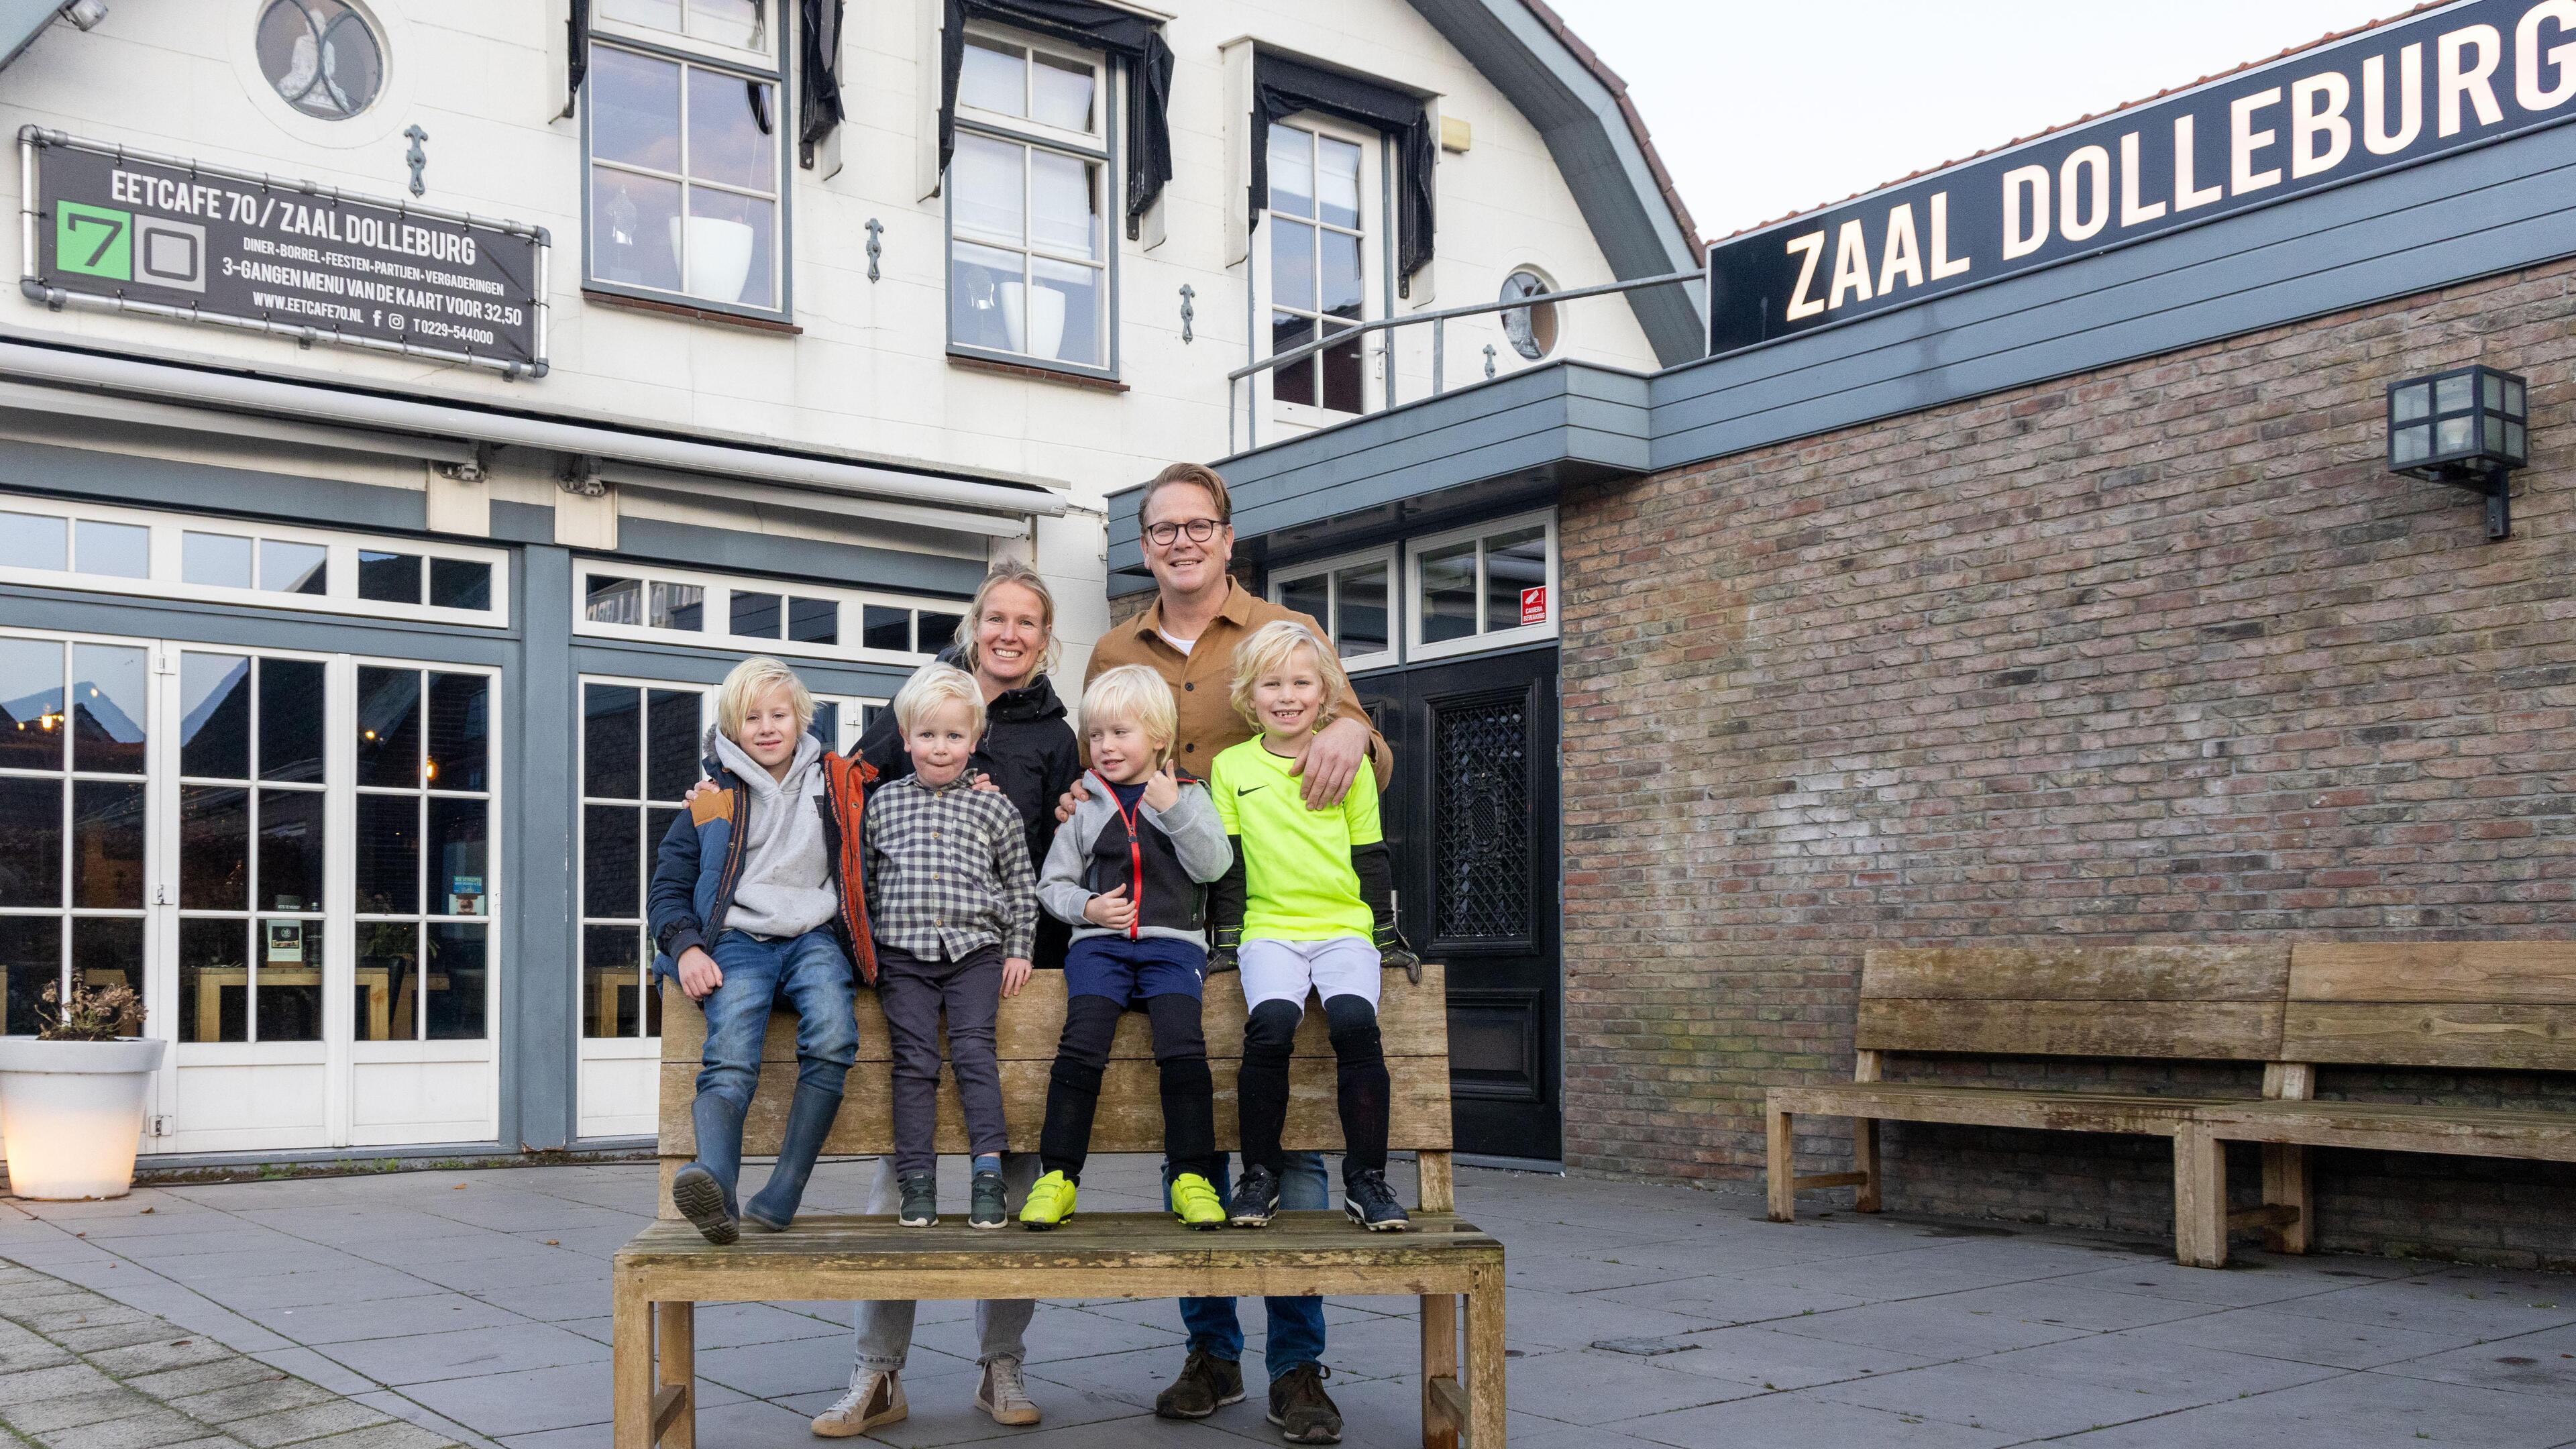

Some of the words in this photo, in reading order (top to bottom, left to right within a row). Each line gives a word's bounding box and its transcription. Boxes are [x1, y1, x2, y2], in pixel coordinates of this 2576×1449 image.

[1786, 191, 1970, 321] ZAAL
[2002, 0, 2576, 261] DOLLEBURG
[112, 169, 222, 219] EETCAFE
[226, 191, 257, 225] 70
[259, 198, 276, 228] /
[280, 201, 342, 241] ZAAL
[345, 214, 476, 266] DOLLEBURG
[222, 256, 301, 288] 3-GANGEN
[303, 270, 344, 295] MENU
[346, 278, 375, 300] VAN
[376, 284, 394, 304] DE
[396, 286, 443, 312] KAART
[445, 295, 482, 319] VOOR
[484, 303, 523, 326] 32,50
[252, 291, 364, 323] WWW.EETCAFE70.NL
[421, 320, 494, 345] 0229-544000
[1523, 612, 1546, 622] BEWAKING
[1525, 606, 1543, 614] CAMERA
